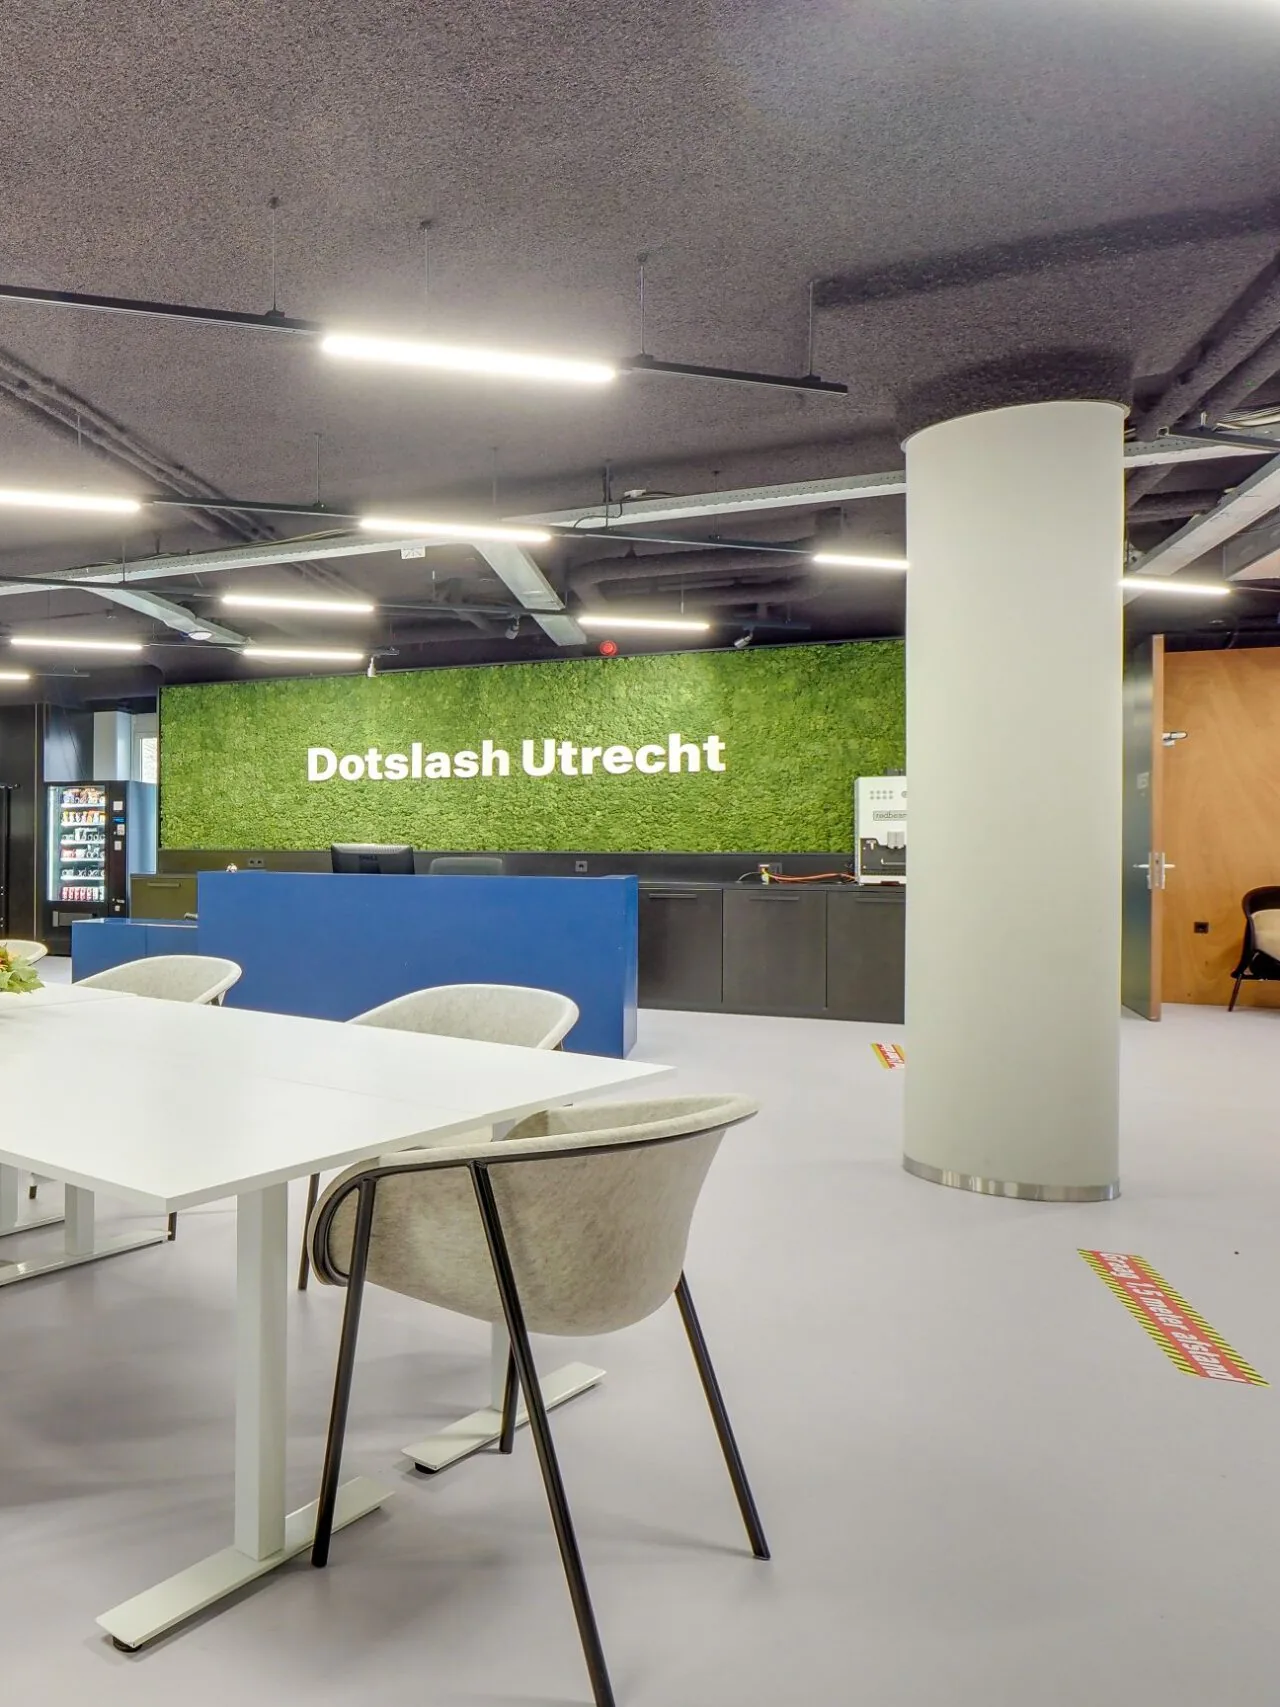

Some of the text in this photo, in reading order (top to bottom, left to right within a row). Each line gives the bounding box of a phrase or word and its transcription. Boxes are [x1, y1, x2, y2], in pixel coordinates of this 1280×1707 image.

[307, 733, 727, 782] Dotslash Utrecht
[1099, 1251, 1140, 1279] Graag
[1139, 1296, 1190, 1331] meter
[1170, 1331, 1248, 1382] afstand
